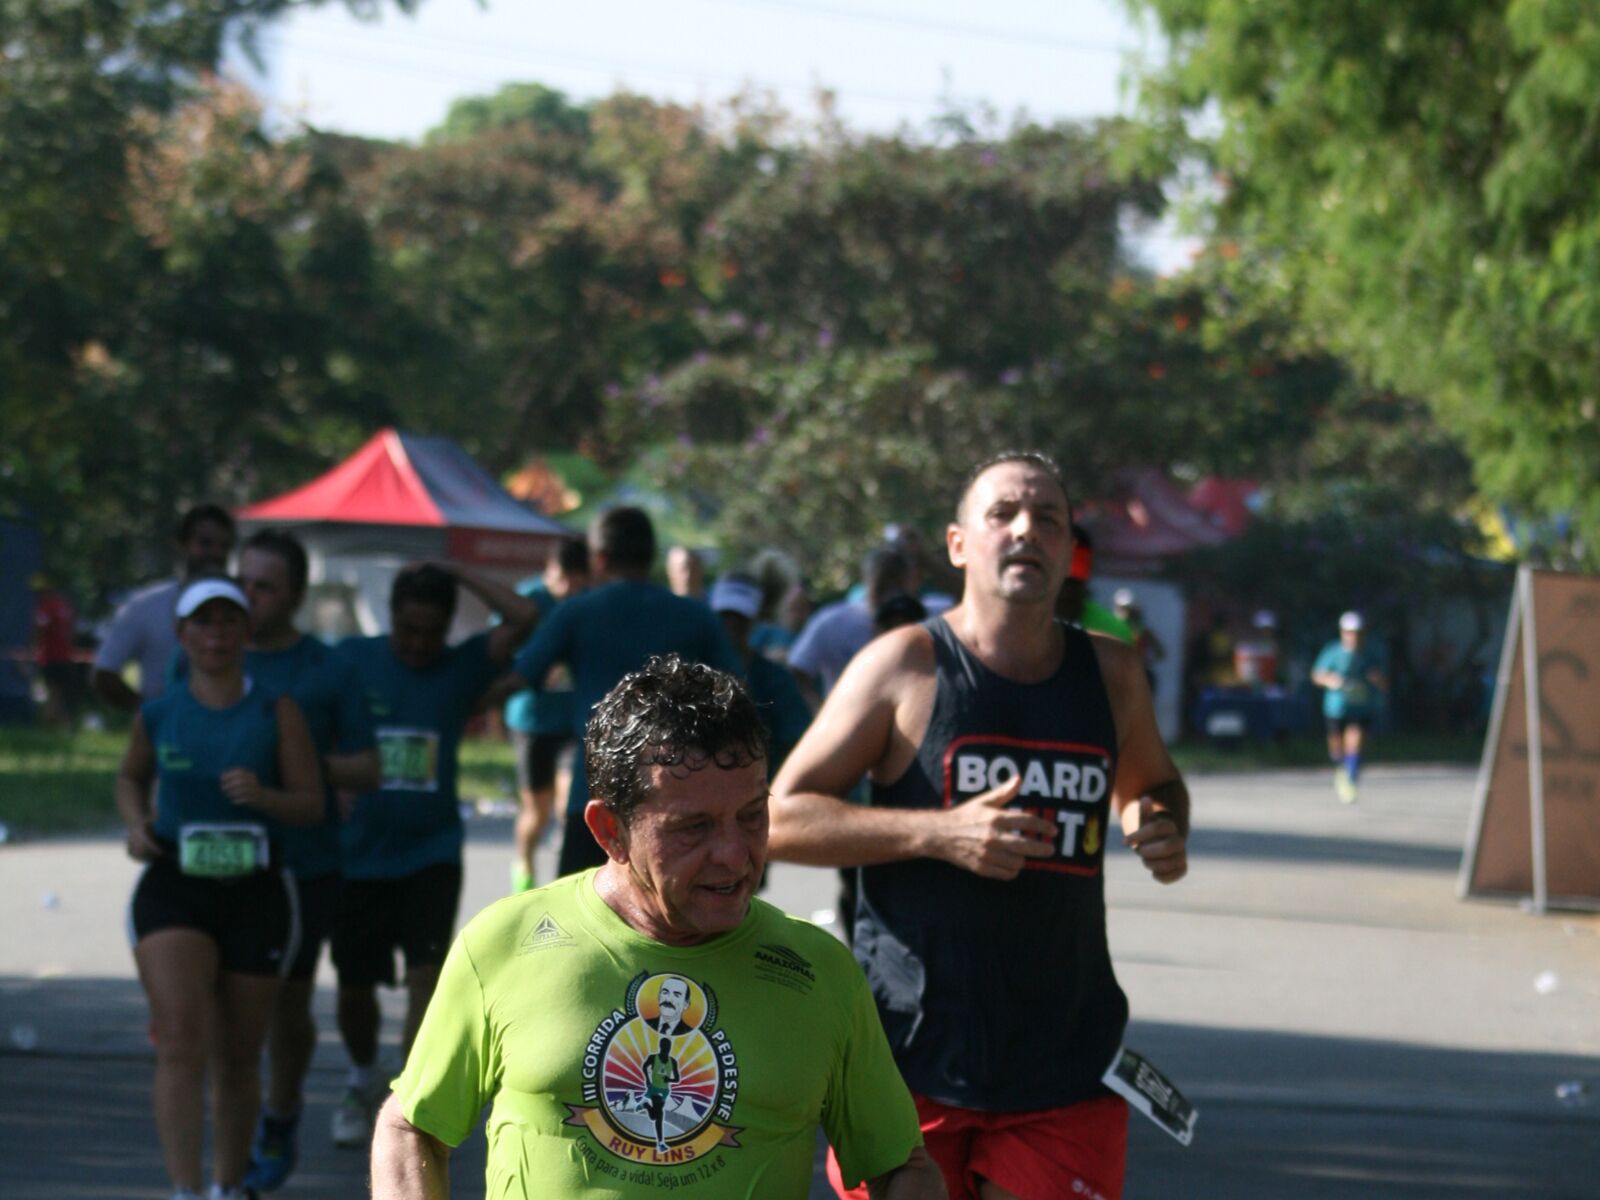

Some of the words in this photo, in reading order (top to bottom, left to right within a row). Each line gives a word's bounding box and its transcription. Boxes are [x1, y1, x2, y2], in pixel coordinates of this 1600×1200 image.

[957, 755, 1107, 803] BOARD
[583, 1011, 626, 1078] CORRIDA
[584, 1083, 596, 1101] III
[575, 1135, 596, 1164] Corra
[596, 1157, 618, 1178] para
[619, 1172, 626, 1182] a
[628, 1171, 655, 1186] vida!
[657, 1172, 680, 1190] Seja
[681, 1174, 698, 1187] um
[609, 1136, 645, 1160] RUY
[652, 1145, 696, 1163] LINS
